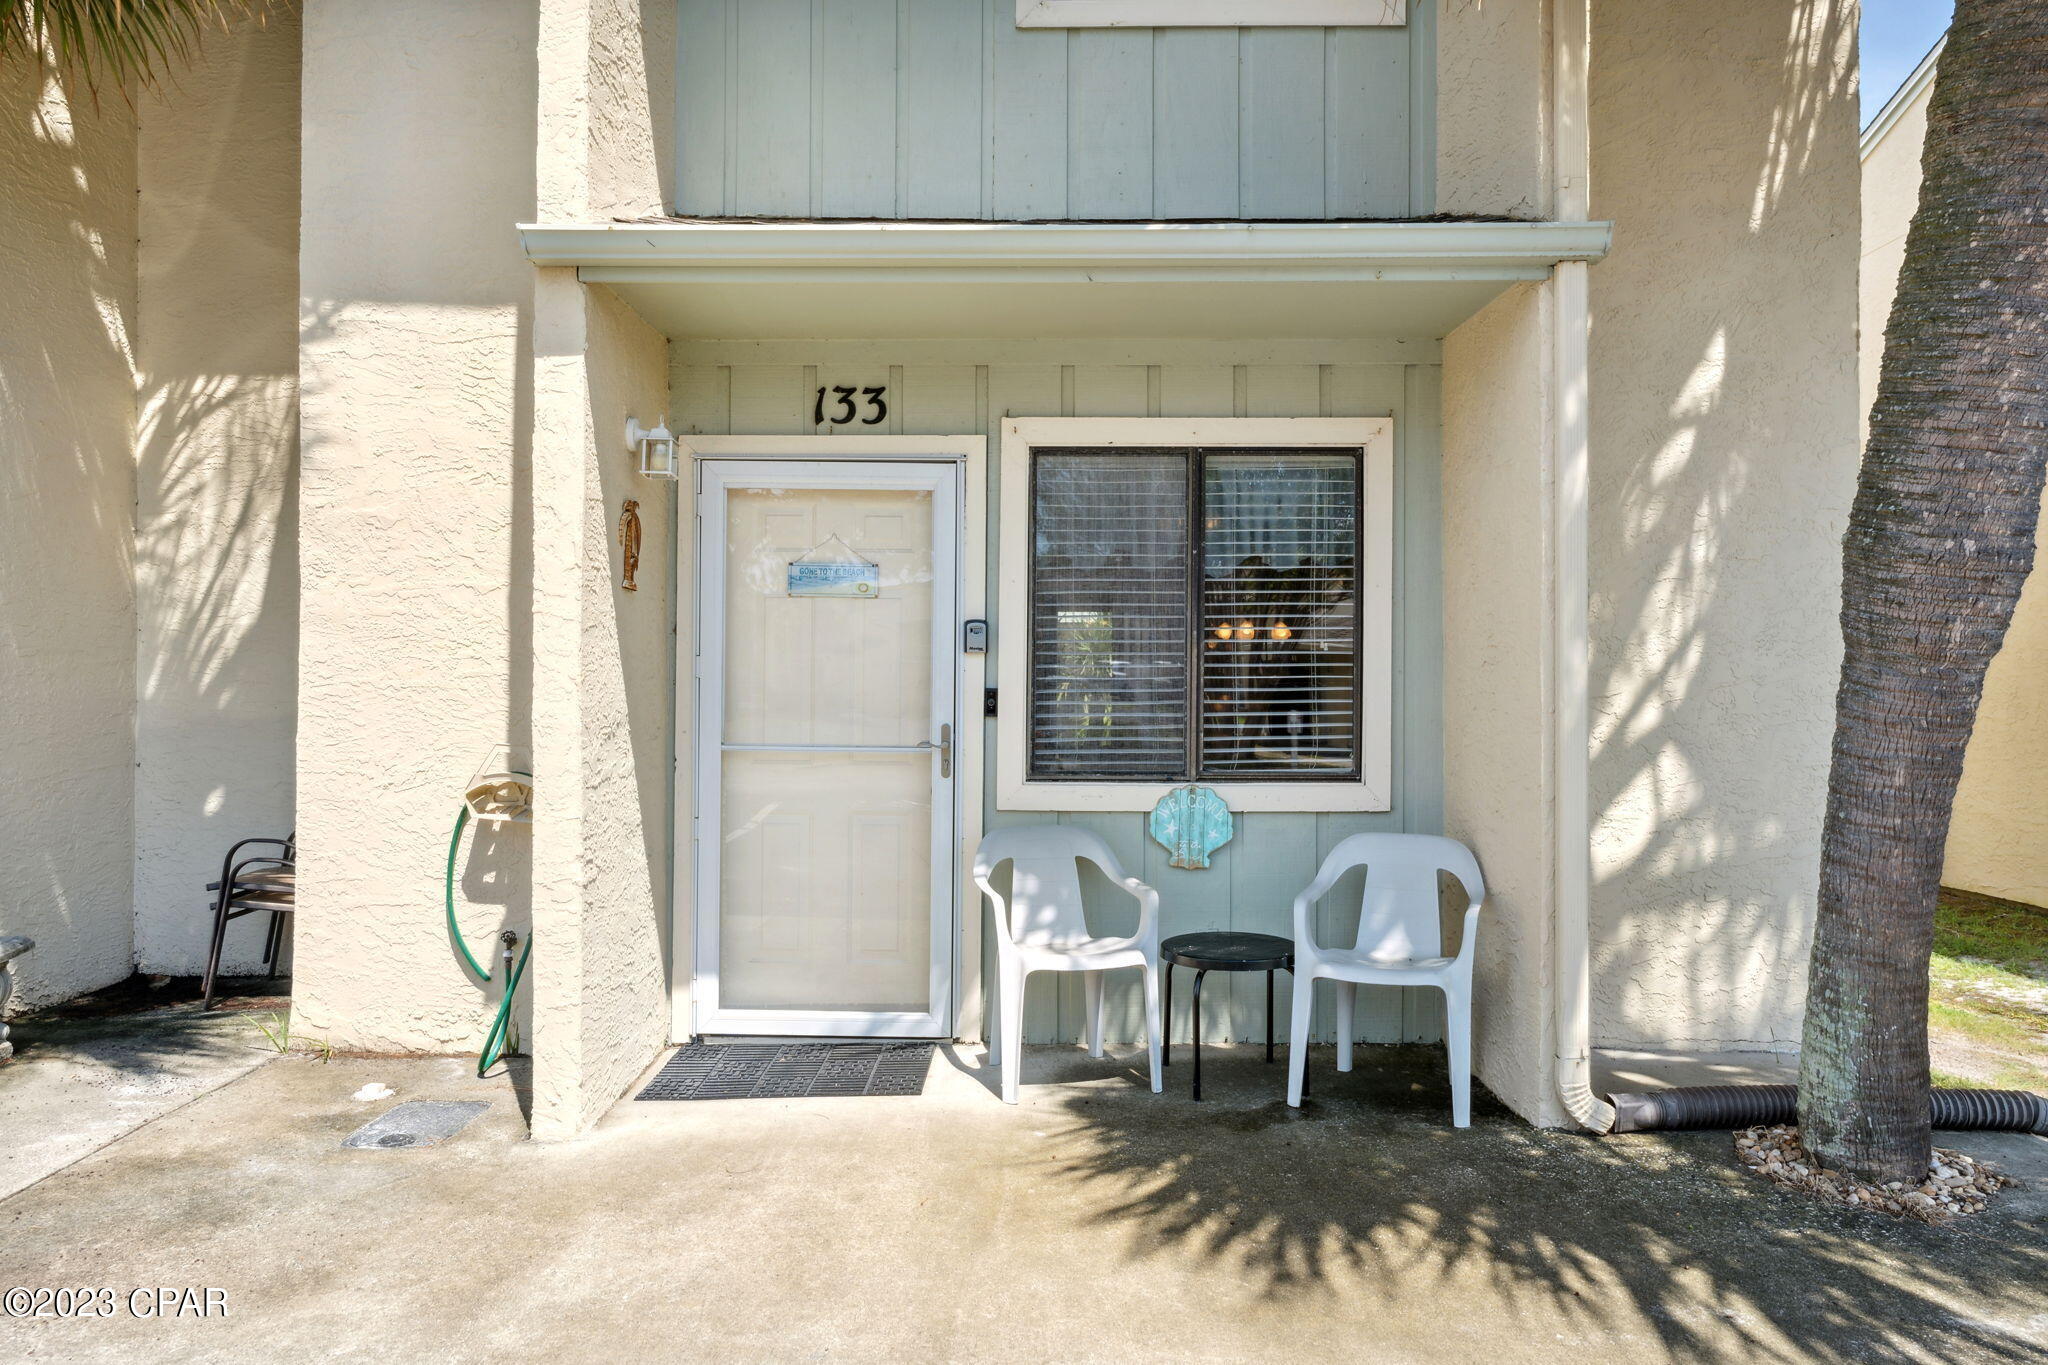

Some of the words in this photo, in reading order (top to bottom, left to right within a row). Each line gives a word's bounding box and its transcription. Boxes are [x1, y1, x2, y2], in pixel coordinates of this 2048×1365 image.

[815, 385, 887, 425] 133
[799, 567, 818, 576] GONE
[818, 567, 828, 576] TO
[1157, 794, 1227, 822] WELCOME
